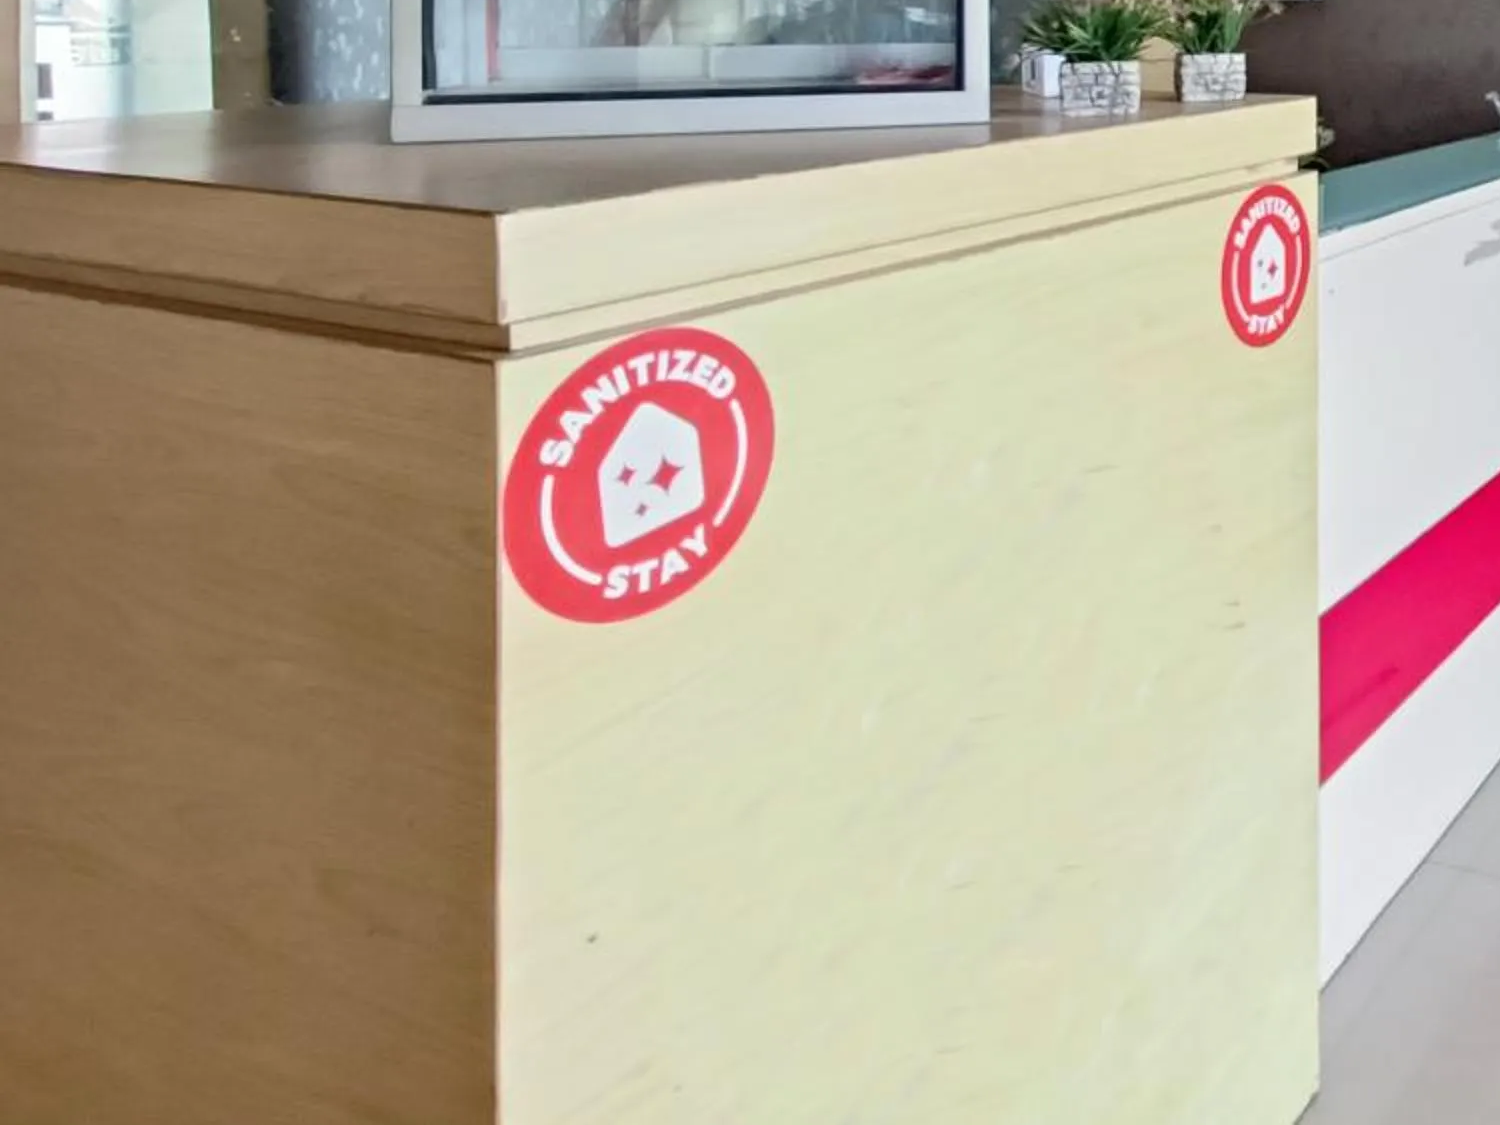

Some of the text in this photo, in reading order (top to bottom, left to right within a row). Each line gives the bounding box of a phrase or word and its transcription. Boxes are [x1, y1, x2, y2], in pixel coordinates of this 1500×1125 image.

[1248, 305, 1285, 334] STAY
[538, 349, 736, 468] SANITIZED
[602, 522, 710, 599] STAY
